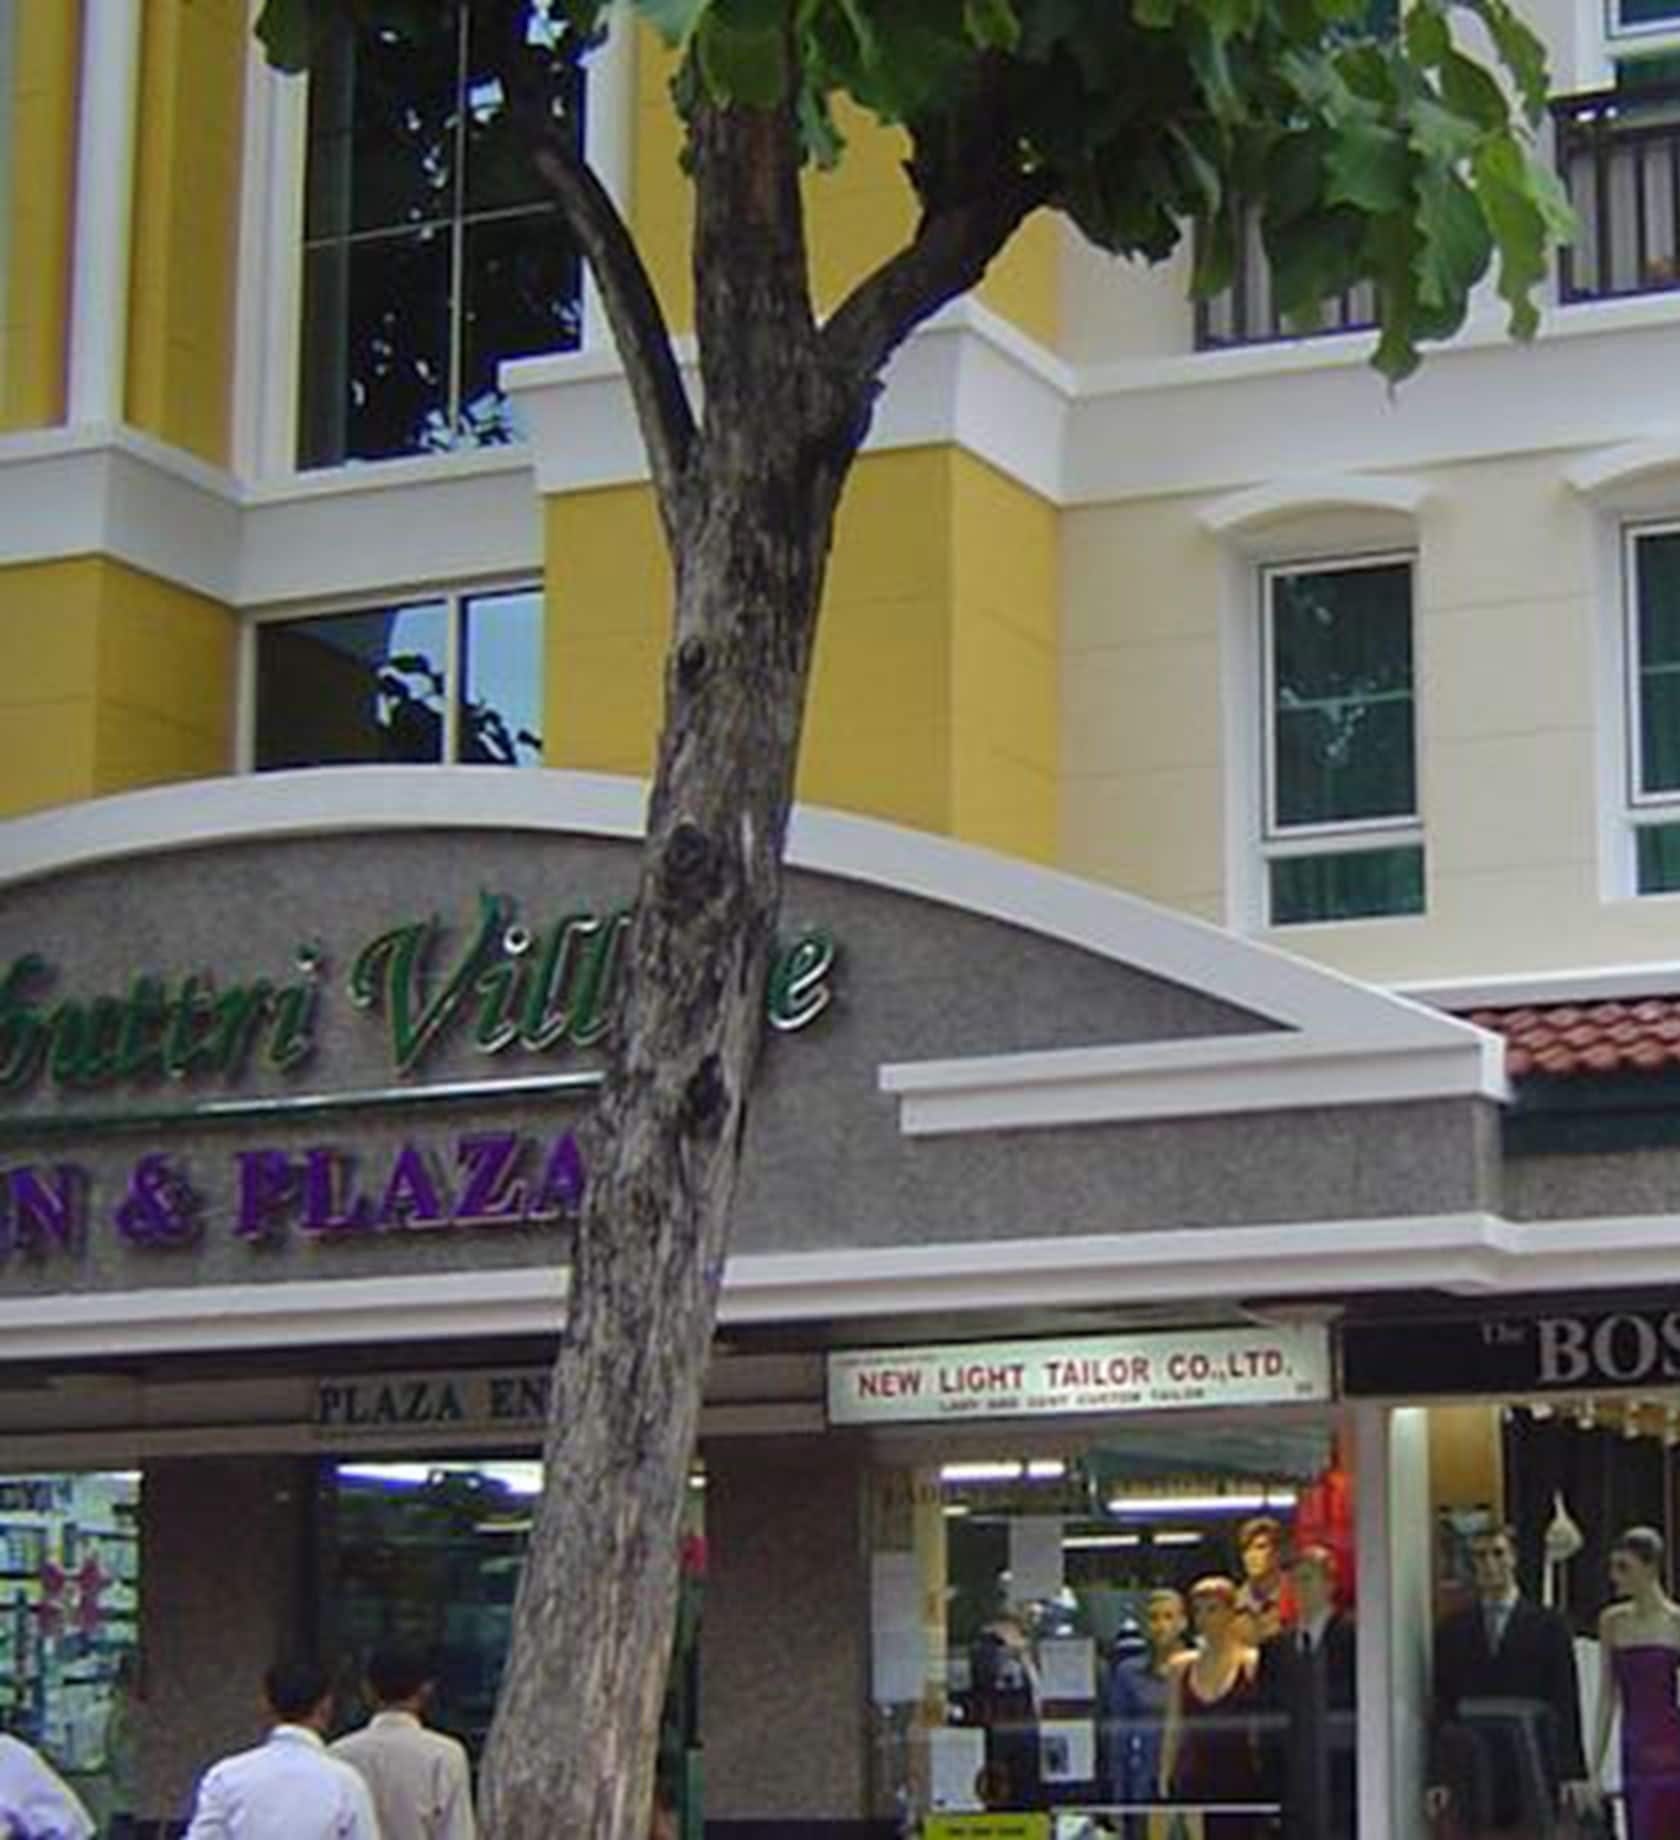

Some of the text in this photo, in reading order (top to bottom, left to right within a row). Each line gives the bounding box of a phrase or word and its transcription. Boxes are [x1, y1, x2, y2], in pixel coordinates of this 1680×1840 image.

[348, 888, 836, 1074] Ville
[115, 1151, 196, 1245] &
[234, 1130, 586, 1242] PLAZA
[319, 1382, 463, 1424] PLAZA
[858, 1371, 922, 1398] NEW
[939, 1364, 1025, 1393] LIGHT
[1045, 1356, 1150, 1388] TAILOR
